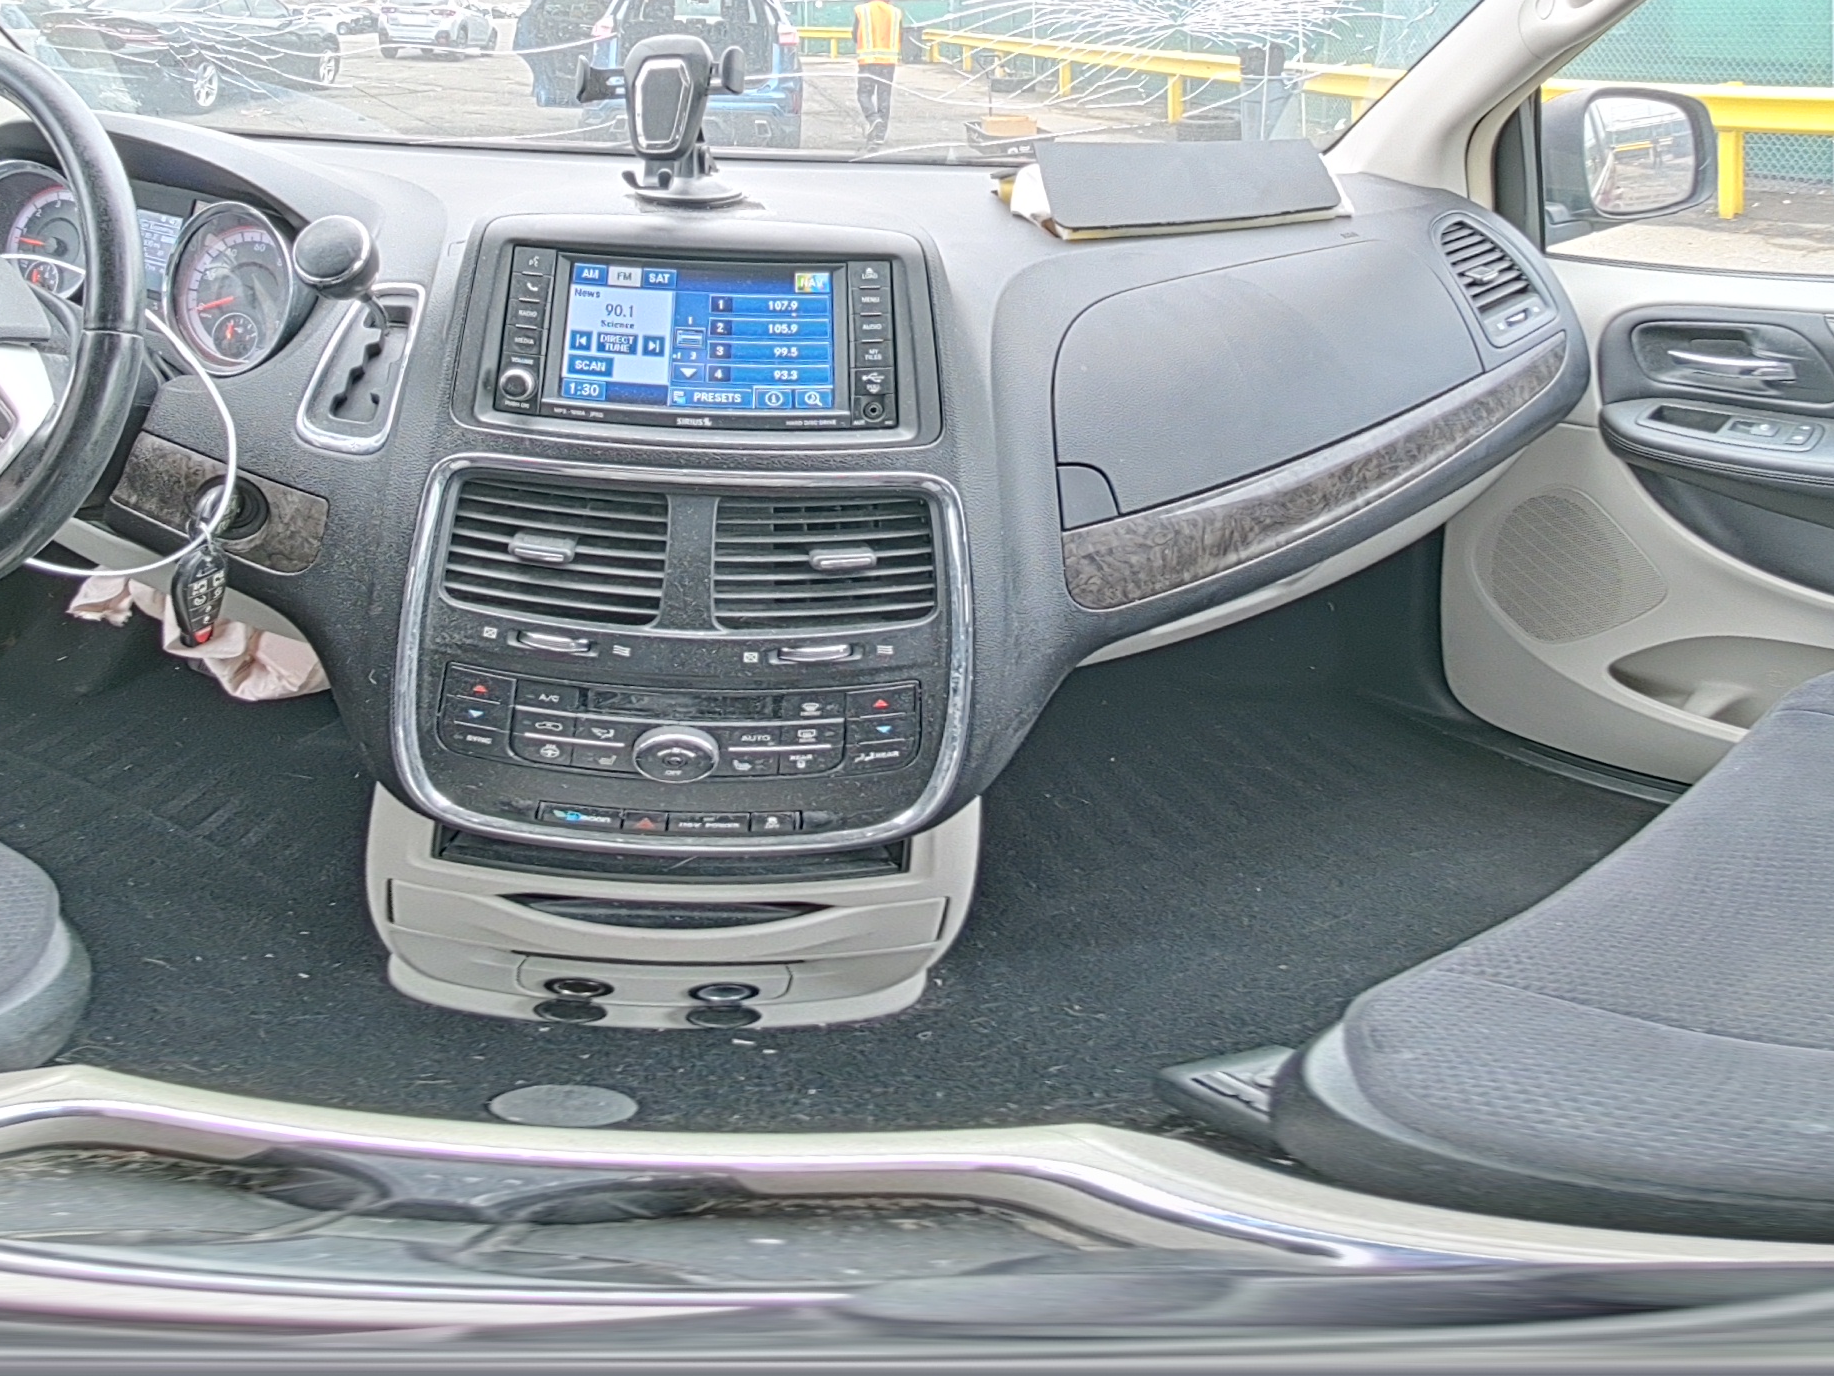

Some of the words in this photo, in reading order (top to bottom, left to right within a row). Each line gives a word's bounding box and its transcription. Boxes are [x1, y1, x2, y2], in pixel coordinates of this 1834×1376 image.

[581, 268, 599, 280] AM
[617, 271, 632, 281] FM
[649, 274, 670, 284] SAT
[801, 277, 824, 288] NAV
[574, 288, 600, 298] News
[605, 303, 634, 318] 90.1
[718, 300, 724, 310] 1
[768, 300, 798, 311] 107.9
[601, 319, 635, 329] Science
[716, 323, 724, 333] 2
[768, 324, 798, 334] 105.9
[600, 334, 635, 345] DIRECT
[605, 343, 630, 353] TUNE
[716, 346, 724, 356] 3
[773, 347, 798, 357] 99.5
[575, 359, 606, 372] SCAN
[714, 369, 723, 379] 4
[773, 370, 798, 380] 93.3
[569, 383, 600, 396] 1:30
[693, 392, 742, 403] PRESETS
[538, 692, 560, 703] A/C
[741, 733, 771, 742] AUTO
